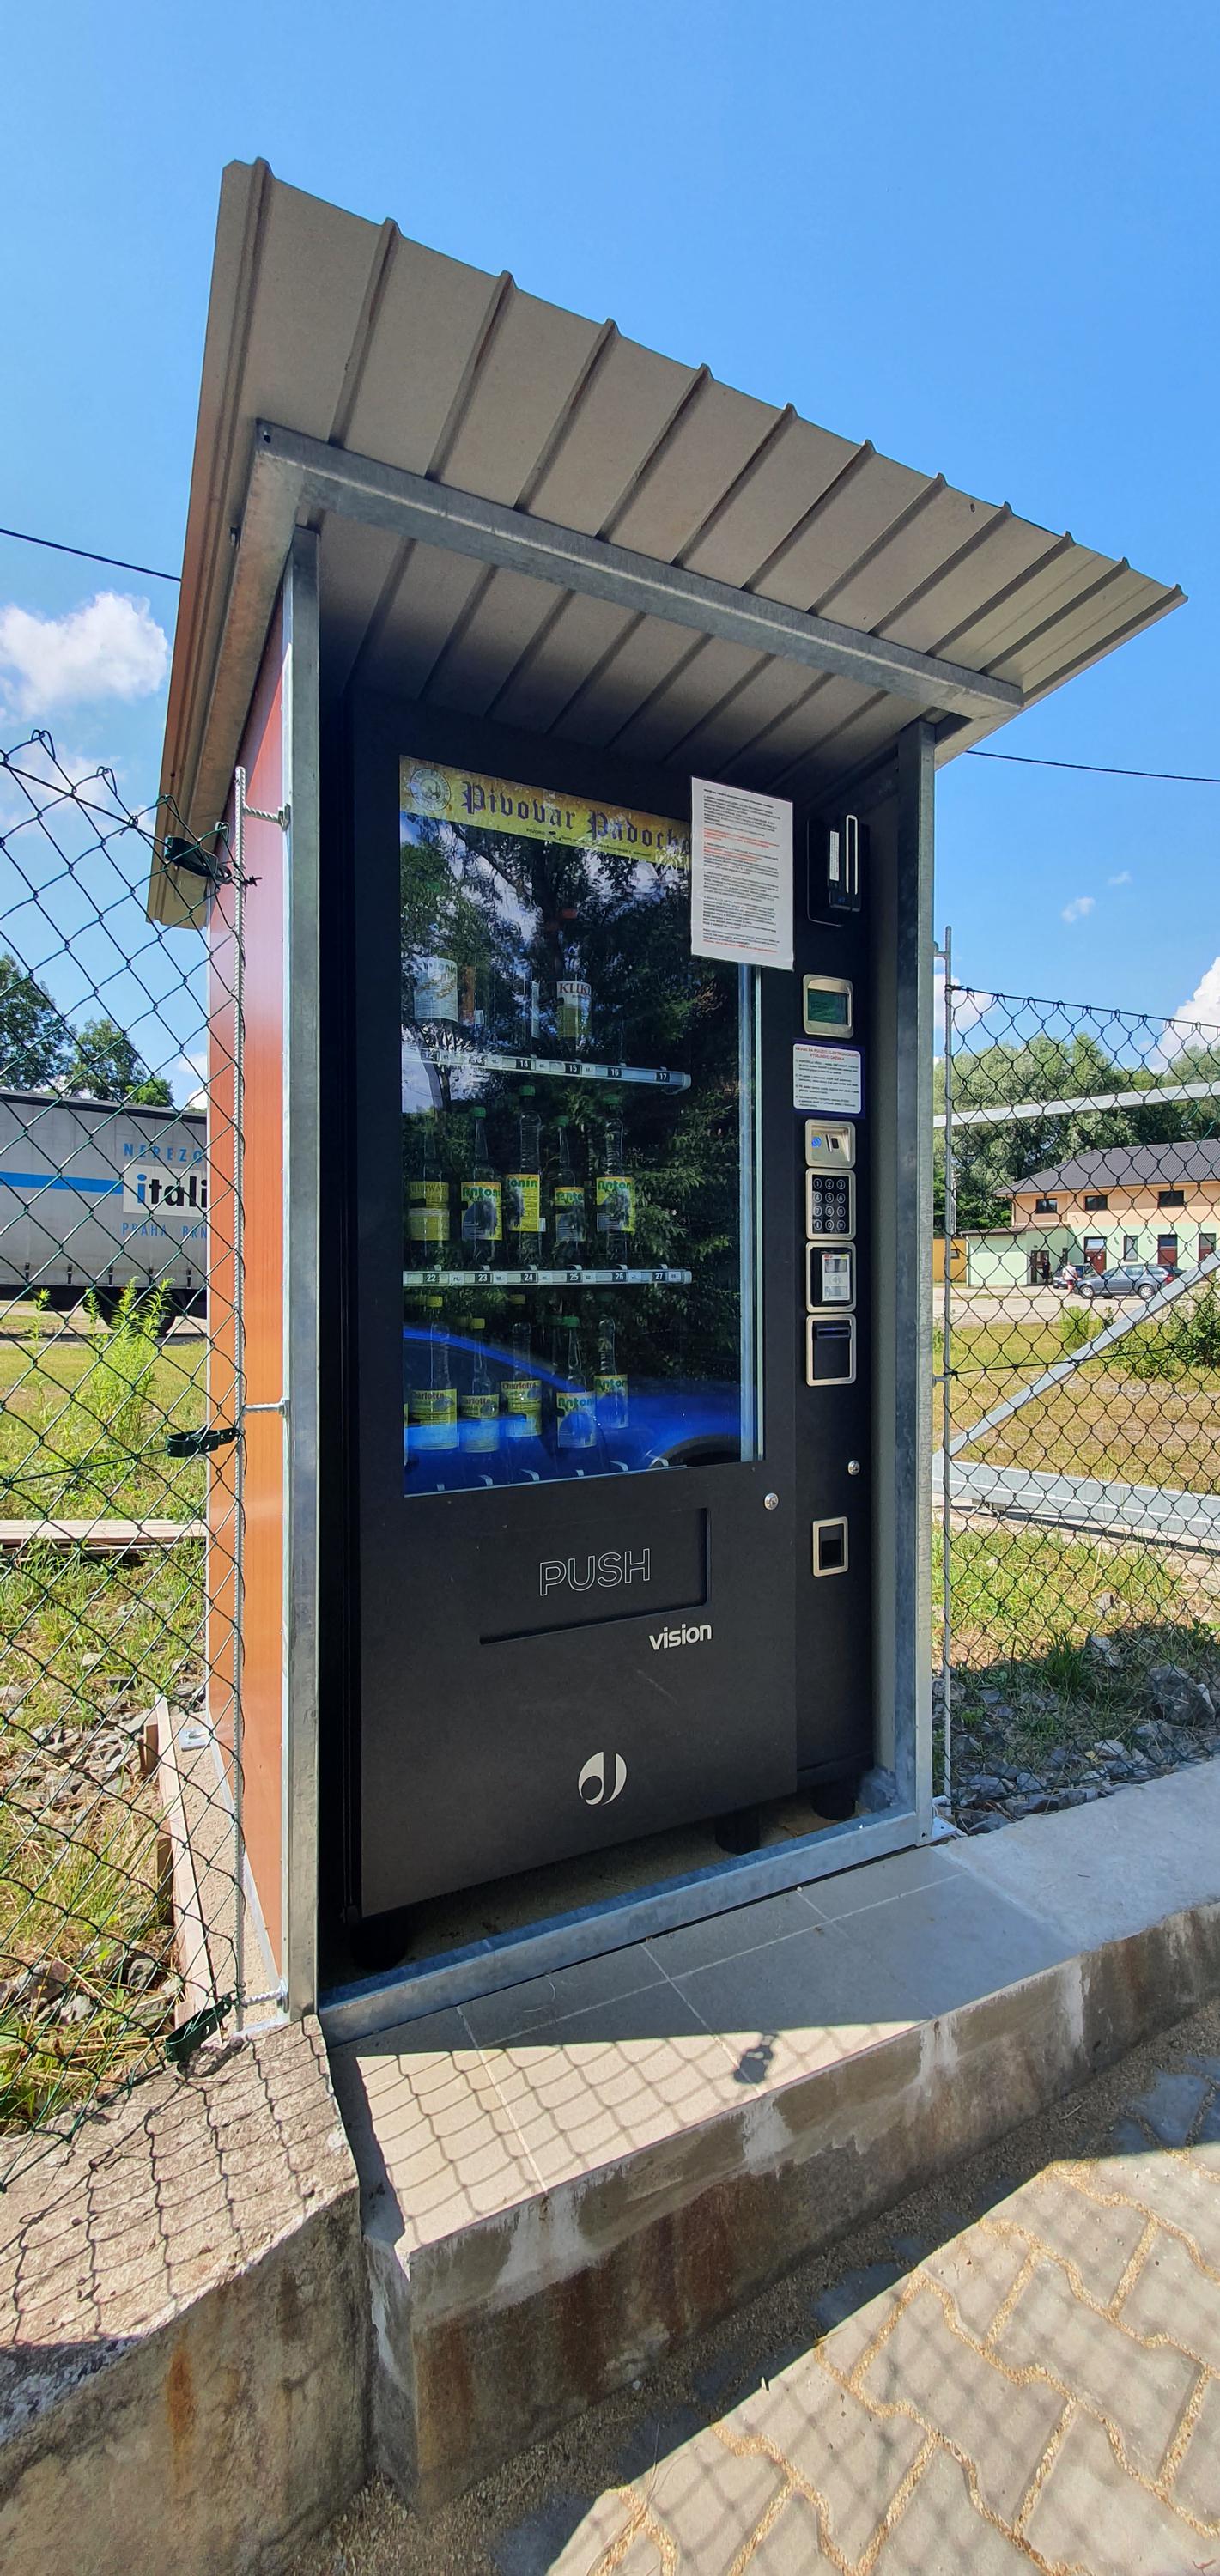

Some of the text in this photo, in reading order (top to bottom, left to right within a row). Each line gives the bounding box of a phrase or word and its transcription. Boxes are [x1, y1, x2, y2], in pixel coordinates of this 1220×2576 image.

[462, 781, 576, 830] Pivovar
[519, 1060, 529, 1068] 14
[568, 1064, 578, 1072] 15
[610, 1068, 619, 1077] 16
[659, 1072, 668, 1081] 17
[426, 1273, 436, 1282] 22
[478, 1273, 488, 1282] 23
[524, 1273, 533, 1282] 24
[569, 1273, 579, 1282] 25
[655, 1272, 664, 1281] 27
[538, 1548, 651, 1596] PUSH
[648, 1624, 713, 1651] vision
